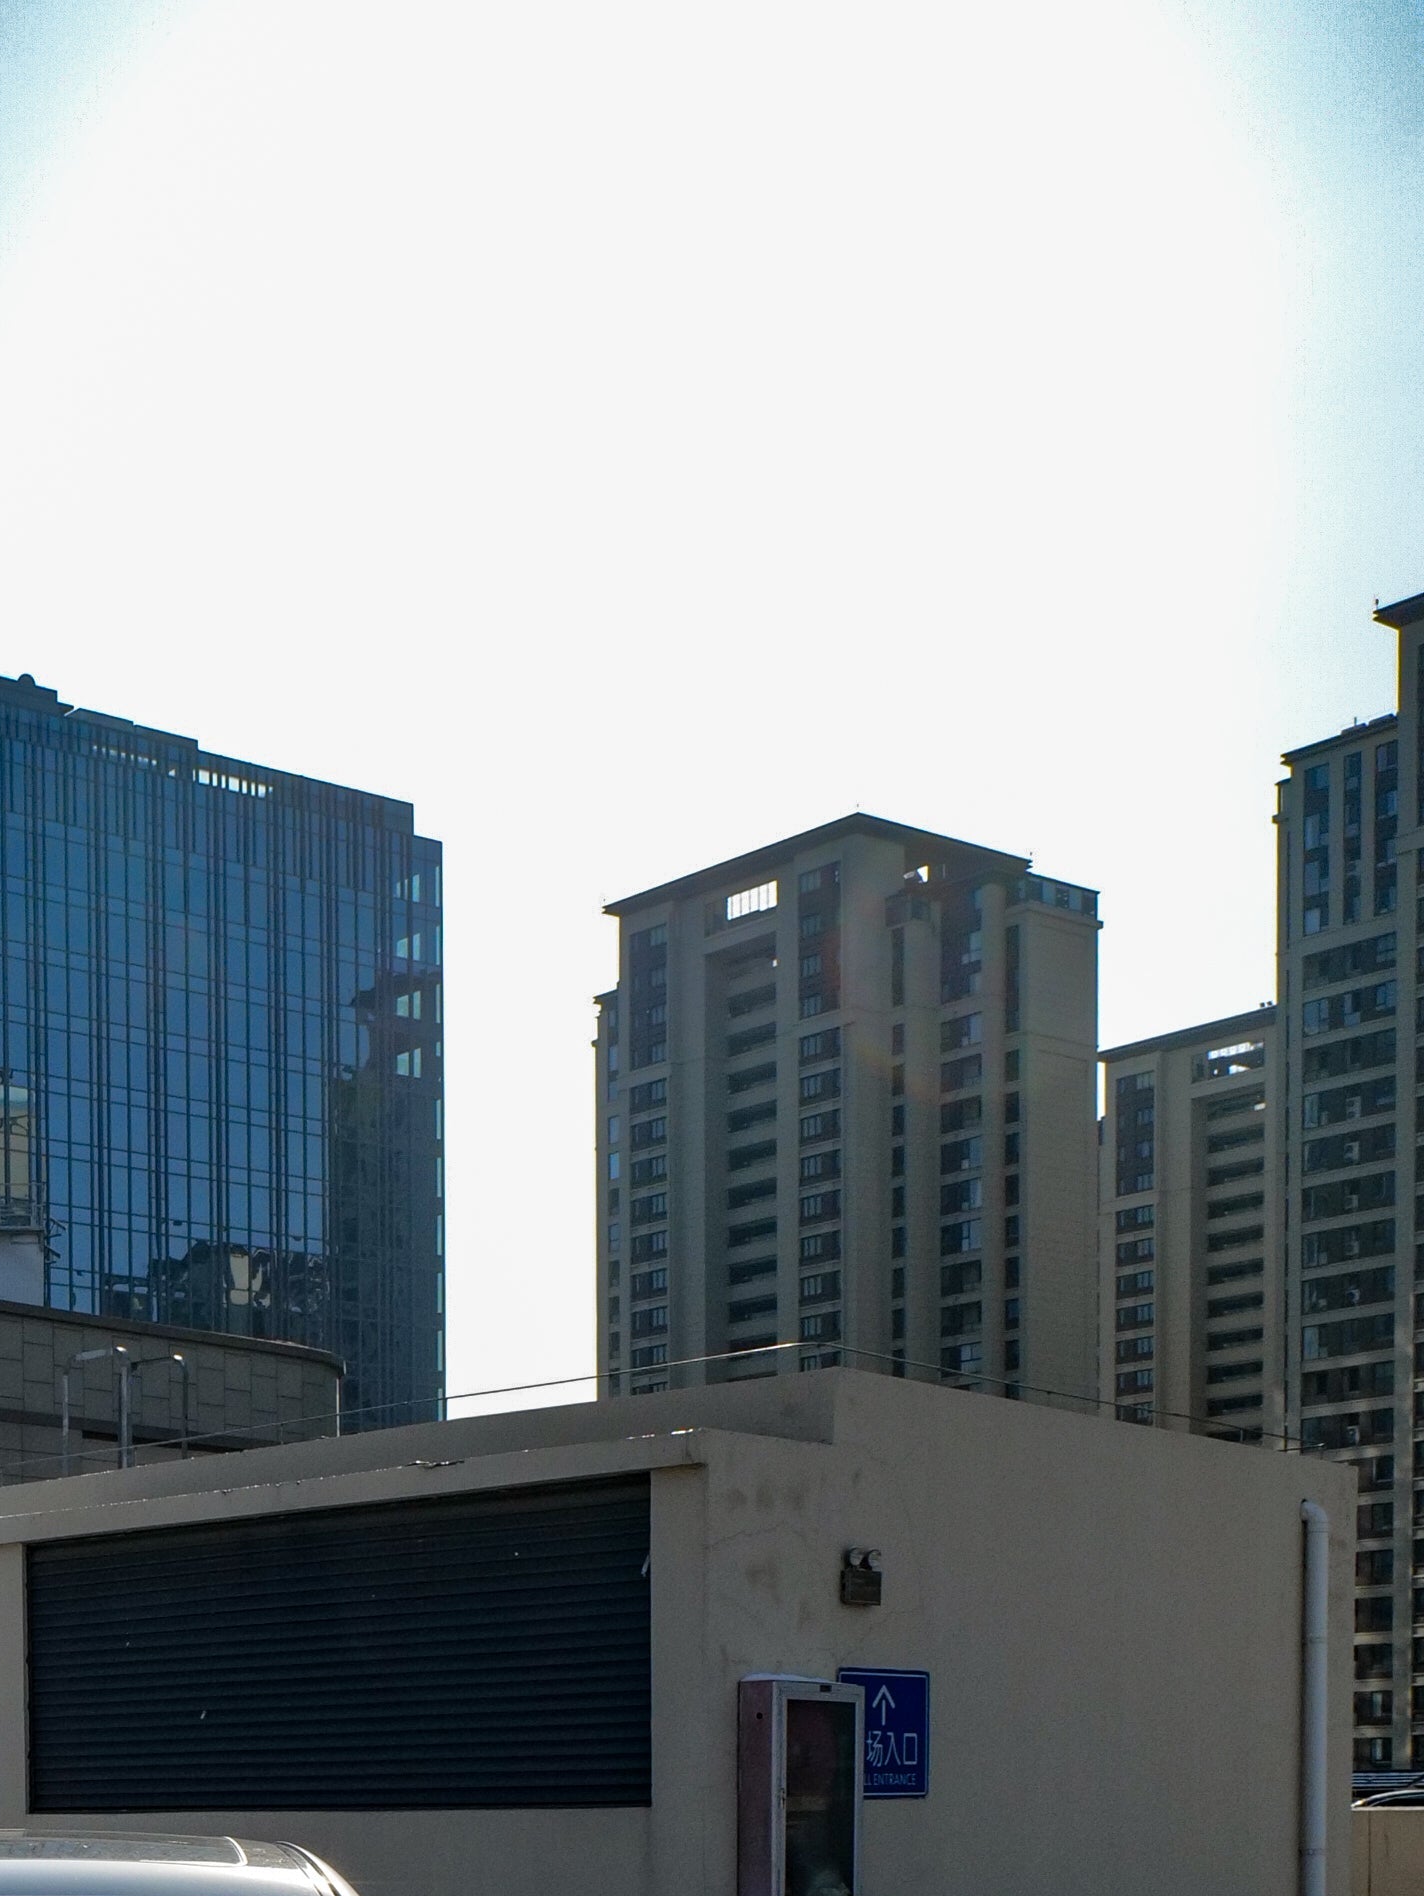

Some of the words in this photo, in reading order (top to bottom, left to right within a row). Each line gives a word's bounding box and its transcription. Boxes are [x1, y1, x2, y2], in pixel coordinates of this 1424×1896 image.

[866, 1731, 918, 1767] 场入口
[873, 1773, 916, 1786] ENTRANCE
